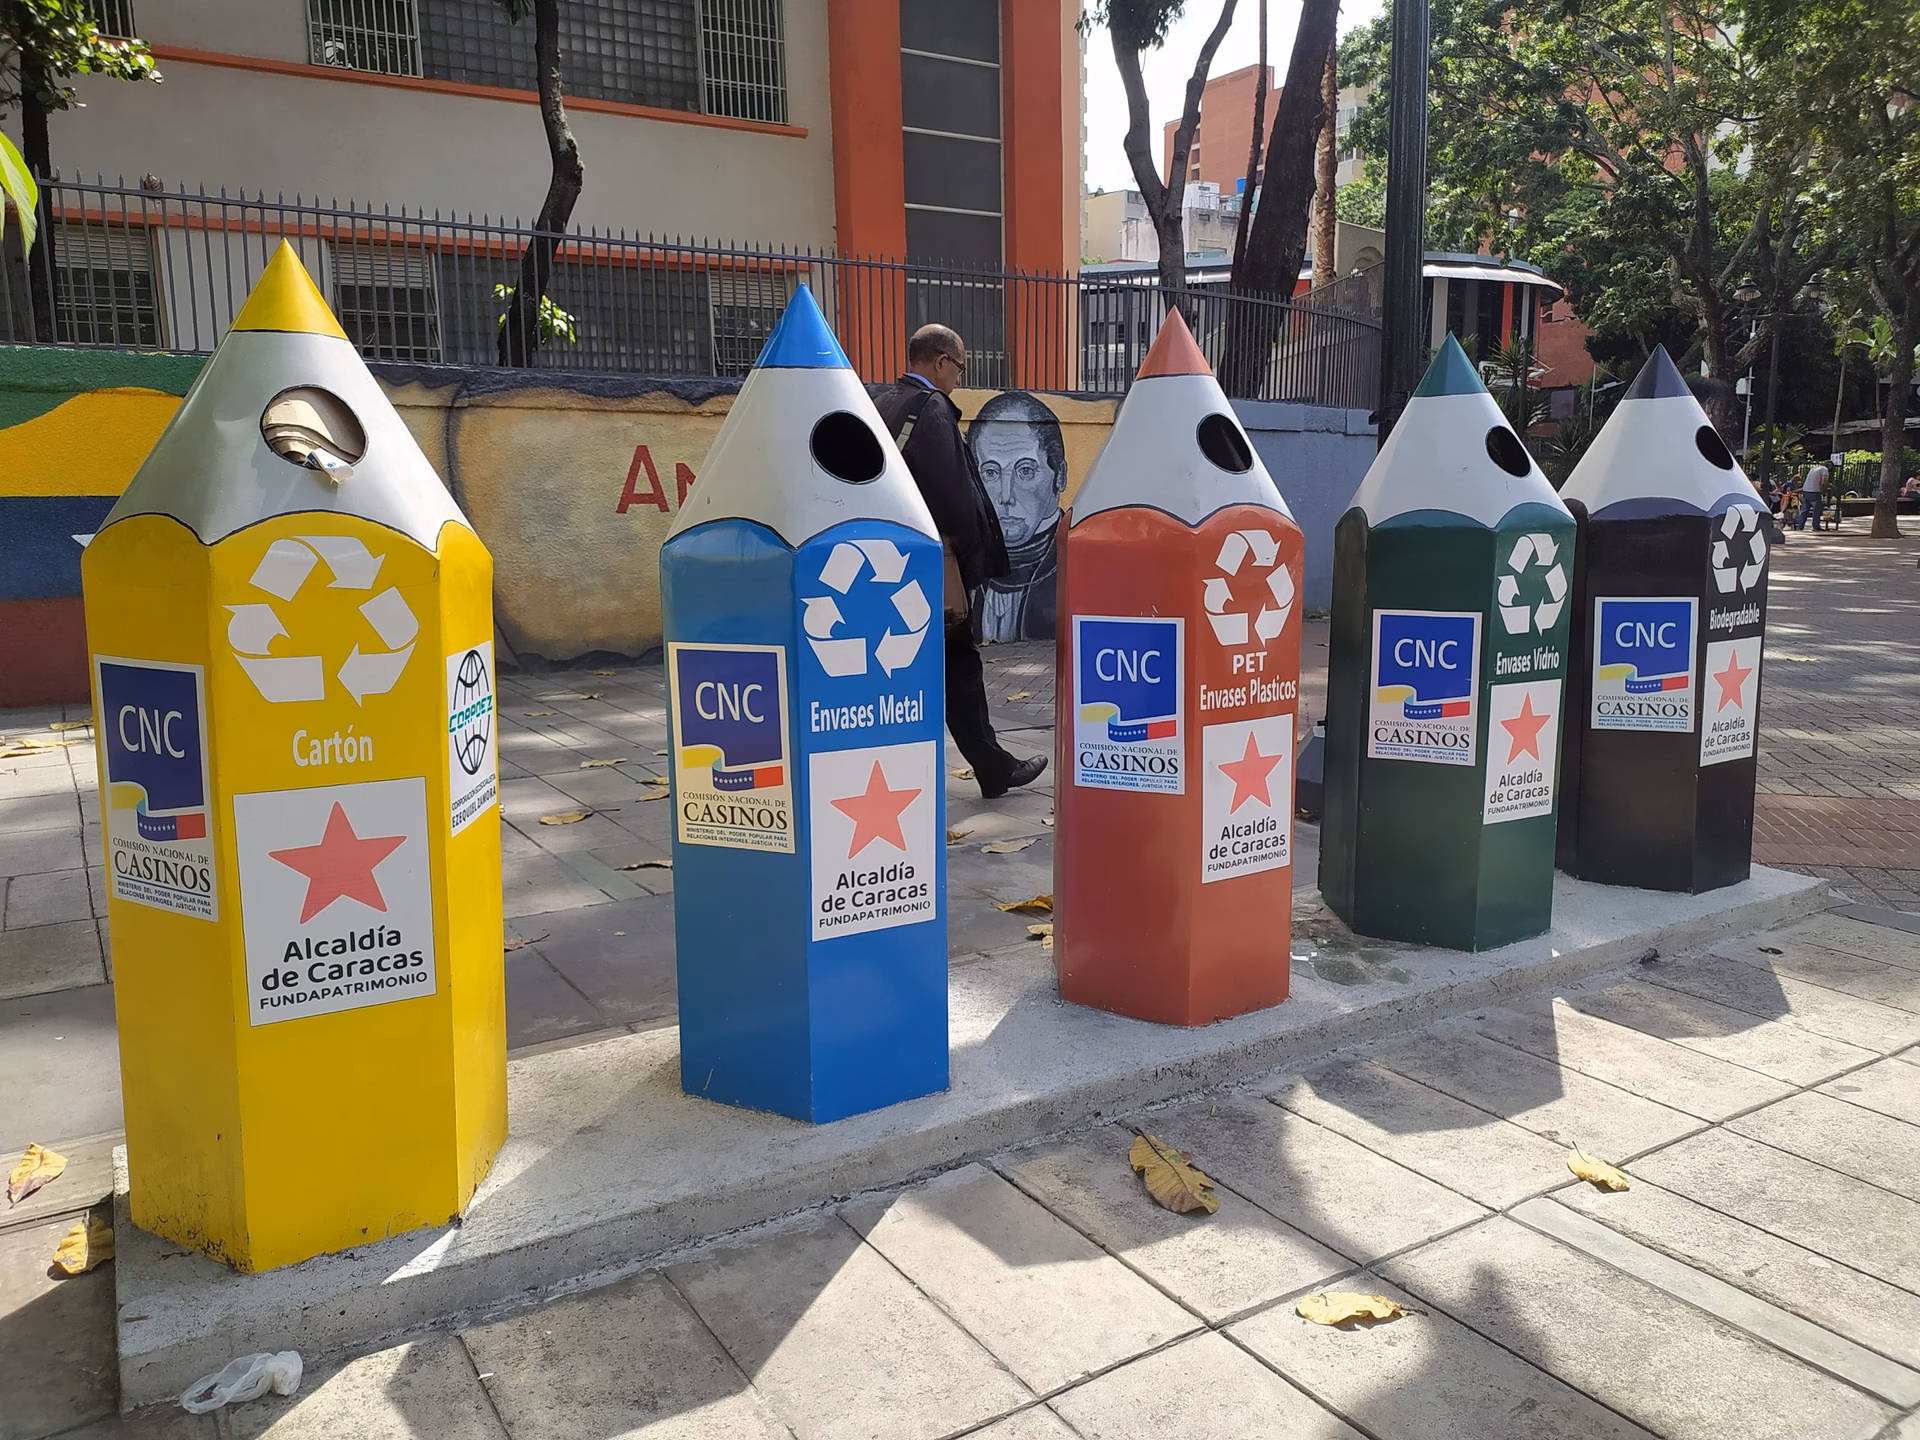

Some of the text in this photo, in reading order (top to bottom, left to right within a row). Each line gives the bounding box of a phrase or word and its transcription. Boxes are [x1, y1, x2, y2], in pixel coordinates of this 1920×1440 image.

[1710, 602, 1759, 633] Biodegradable
[1616, 622, 1676, 648] CNC
[1096, 649, 1160, 683] CNC
[1233, 652, 1267, 674] PET
[1394, 638, 1457, 670] CNC
[1496, 645, 1559, 676] Envases Vidrio
[695, 681, 765, 723] CNC
[1200, 675, 1296, 710] Envases Plasticos
[811, 689, 923, 732] Envases Metal
[1597, 702, 1688, 717] CASINOS
[119, 705, 185, 758] CNC
[1375, 720, 1413, 728] COMISIÓN
[1416, 723, 1458, 731] NACIONAL
[1712, 716, 1745, 733] Alcaldía
[292, 725, 374, 767] Cartón
[1080, 743, 1119, 752] COMISIÓN
[1121, 746, 1164, 755] NACIONAL
[1374, 728, 1470, 748] CASINOS
[1703, 744, 1750, 758] FUNDAPATRIMONIO
[1705, 731, 1750, 748] de Caracas
[1080, 751, 1178, 774] CASINOS
[1499, 769, 1542, 788] Alcaldía
[452, 786, 496, 828] EZEQUIEL ZAMORA
[683, 792, 787, 808] COMISIÓN NACIONAL DE
[1488, 799, 1549, 815] FUNDAPATRIMONIO
[1490, 786, 1549, 804] de Caracas
[684, 802, 788, 830] CASINOS
[1221, 816, 1277, 840] Alcaldía
[686, 827, 714, 835] MINISTERIO
[687, 833, 718, 841] RELACIONES
[113, 836, 209, 865] COMISIÓN NACIONAL DE
[1210, 834, 1286, 859] de Caracas
[114, 850, 211, 893] CASINOS
[1208, 849, 1287, 872] FUNDAPATRIMONIO
[836, 861, 915, 890] Alcaldía
[118, 881, 141, 891] MINISTERIO
[155, 890, 171, 898] PODER
[173, 894, 196, 904] POPULAR
[197, 899, 210, 907] PARA
[118, 888, 145, 900] RELACIONES
[175, 901, 196, 911] JUSTICIA
[821, 883, 927, 913] de Caracas
[819, 900, 930, 928] FUNDAPATRIMONIO
[283, 925, 401, 963] Alcaldía
[262, 950, 424, 991] de Caracas
[260, 971, 428, 1009] FUNDAPATRIMONIO
